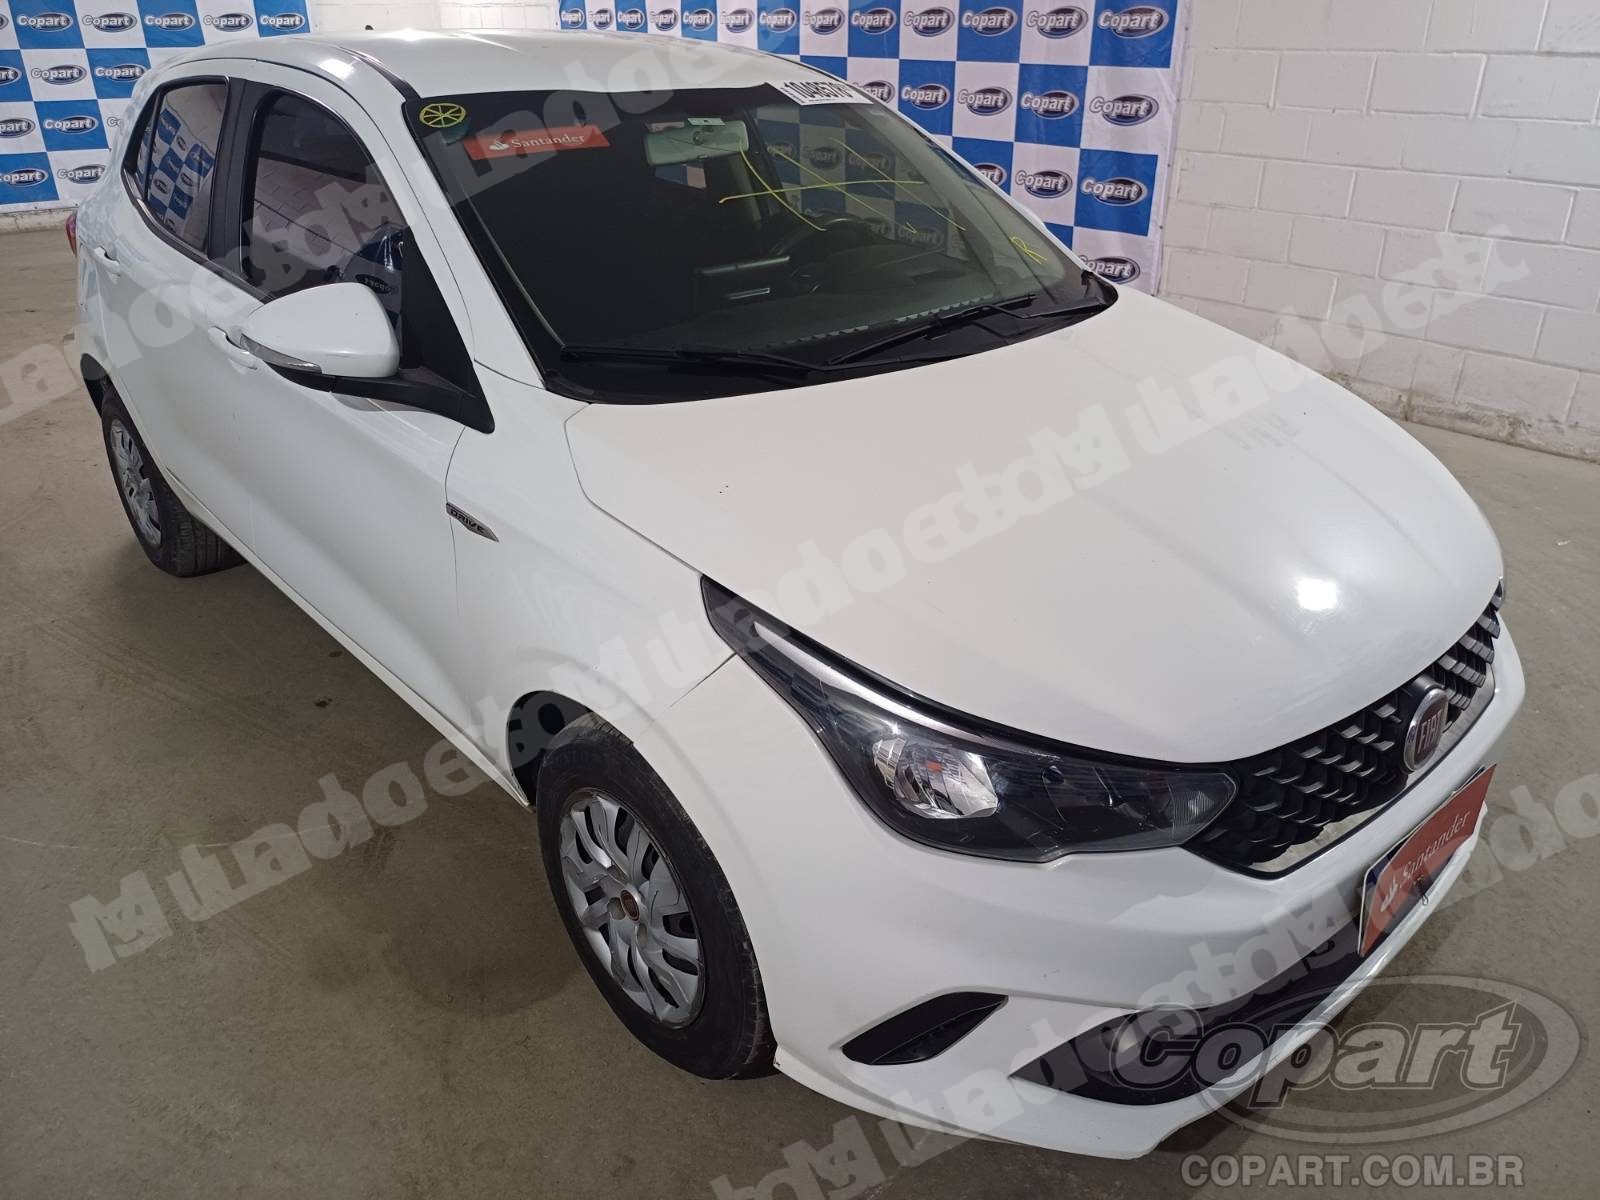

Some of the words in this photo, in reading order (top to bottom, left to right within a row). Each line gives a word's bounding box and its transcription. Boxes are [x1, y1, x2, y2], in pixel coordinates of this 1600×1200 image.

[17, 15, 68, 27] Copart
[82, 14, 130, 28] Copart
[144, 15, 189, 27] Copart
[203, 15, 247, 27] Copart
[260, 15, 301, 27] Copart
[617, 11, 641, 26] Copart
[682, 11, 710, 27] Copart
[720, 11, 750, 26] Copart
[759, 11, 793, 28] Copart
[802, 11, 839, 28] Copart
[851, 11, 891, 29] Copart
[904, 10, 950, 30] Copart
[962, 11, 1011, 31] Copart
[1026, 10, 1081, 32] Copart
[1098, 9, 1162, 34] Copart
[31, 67, 80, 80] Copart
[95, 66, 141, 79] Copart
[901, 84, 945, 102] Copart
[958, 88, 1007, 108] Copart
[1021, 91, 1071, 114] Copart
[1089, 96, 1149, 118] Copart
[43, 119, 92, 131] Copart
[511, 134, 586, 148] Santander
[57, 167, 103, 180] Copart
[1015, 170, 1068, 191] Copart
[1081, 177, 1139, 200] Copart
[450, 509, 485, 534] DRIVE
[1417, 709, 1443, 754] FIAT
[1400, 811, 1471, 889] Santander
